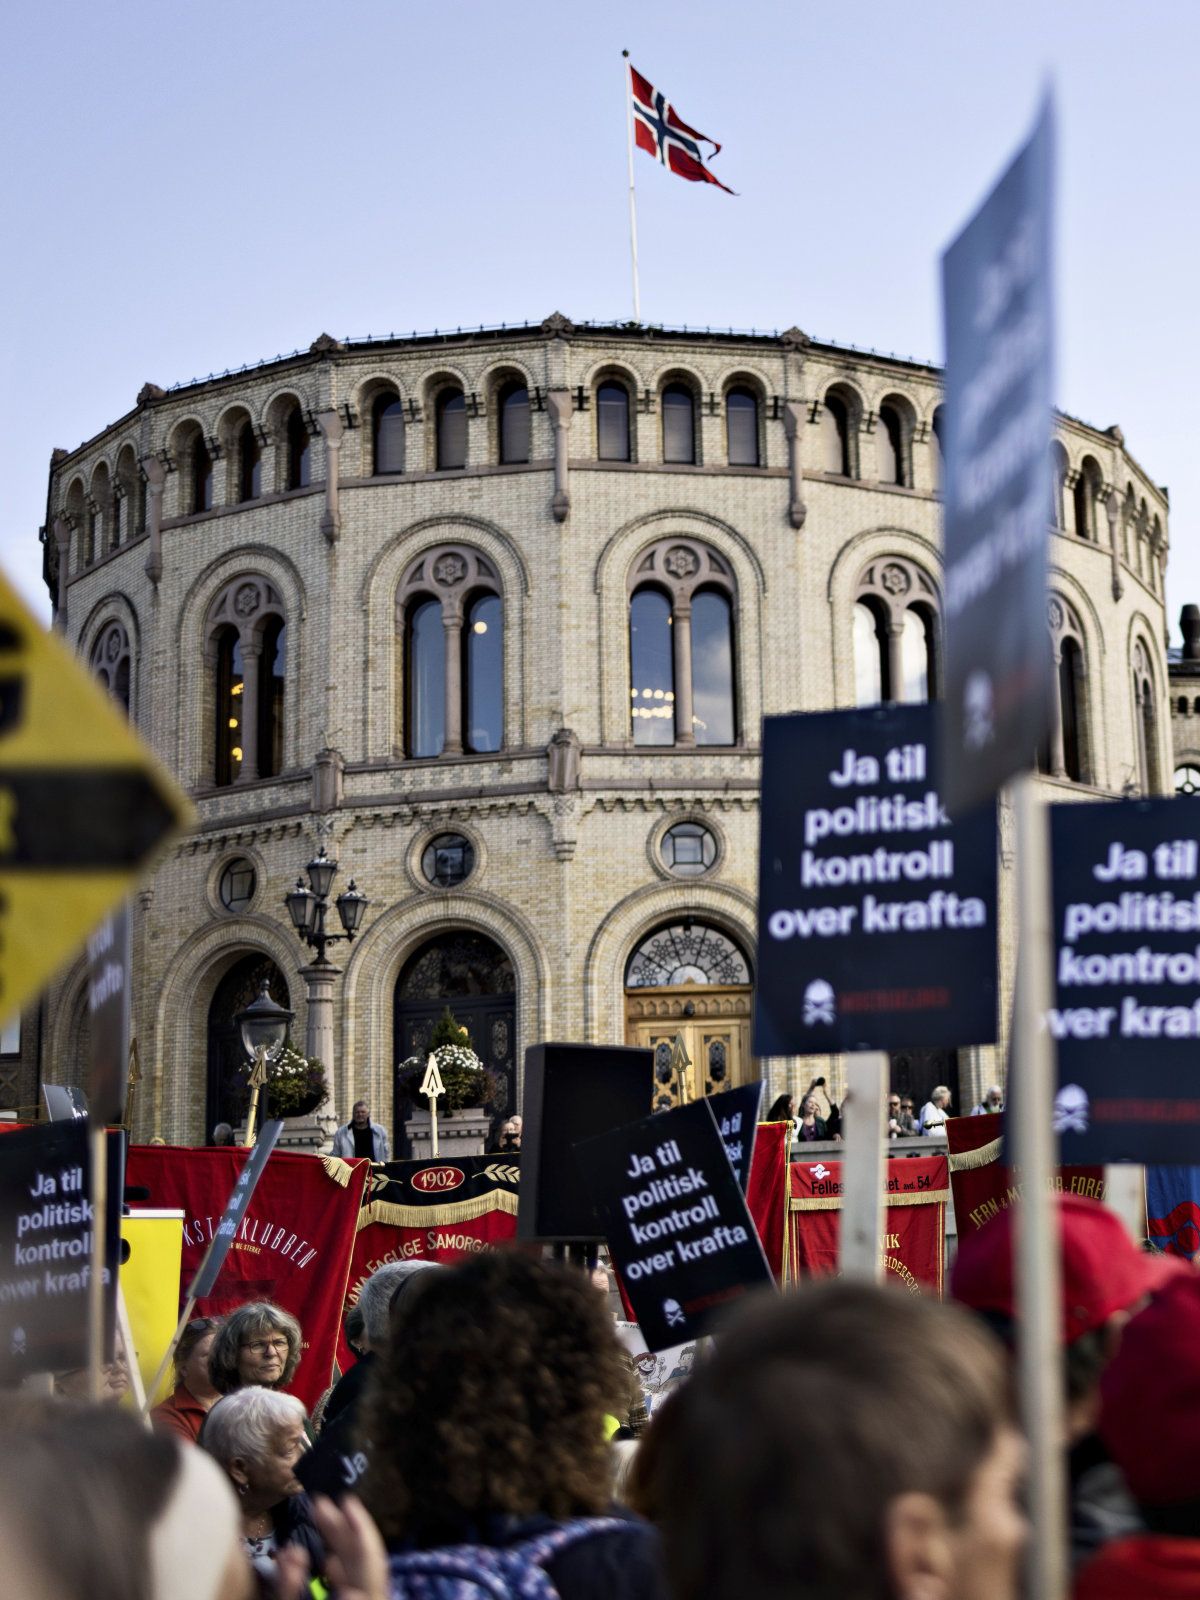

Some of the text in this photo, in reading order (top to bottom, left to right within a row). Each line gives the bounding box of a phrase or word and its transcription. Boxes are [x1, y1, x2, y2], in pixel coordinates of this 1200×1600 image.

[829, 744, 926, 787] Ja til
[801, 840, 953, 888] kontroll
[1093, 839, 1198, 881] Ja til
[768, 890, 986, 939] over krafta
[1042, 1006, 1117, 1039] ver
[627, 1140, 682, 1178] Ja til
[30, 1167, 83, 1197] Ja til
[421, 1170, 456, 1189] 1902
[622, 1166, 708, 1218] politisk
[917, 1175, 931, 1189] 54
[17, 1199, 95, 1238] politisk
[630, 1195, 720, 1245] kontroll
[969, 1197, 999, 1230] JERN
[15, 1231, 95, 1266] kontroll
[626, 1223, 748, 1280] over krafta
[880, 1234, 900, 1249] VIK
[44, 1265, 111, 1295] krafa
[343, 1452, 368, 1484] Ja
